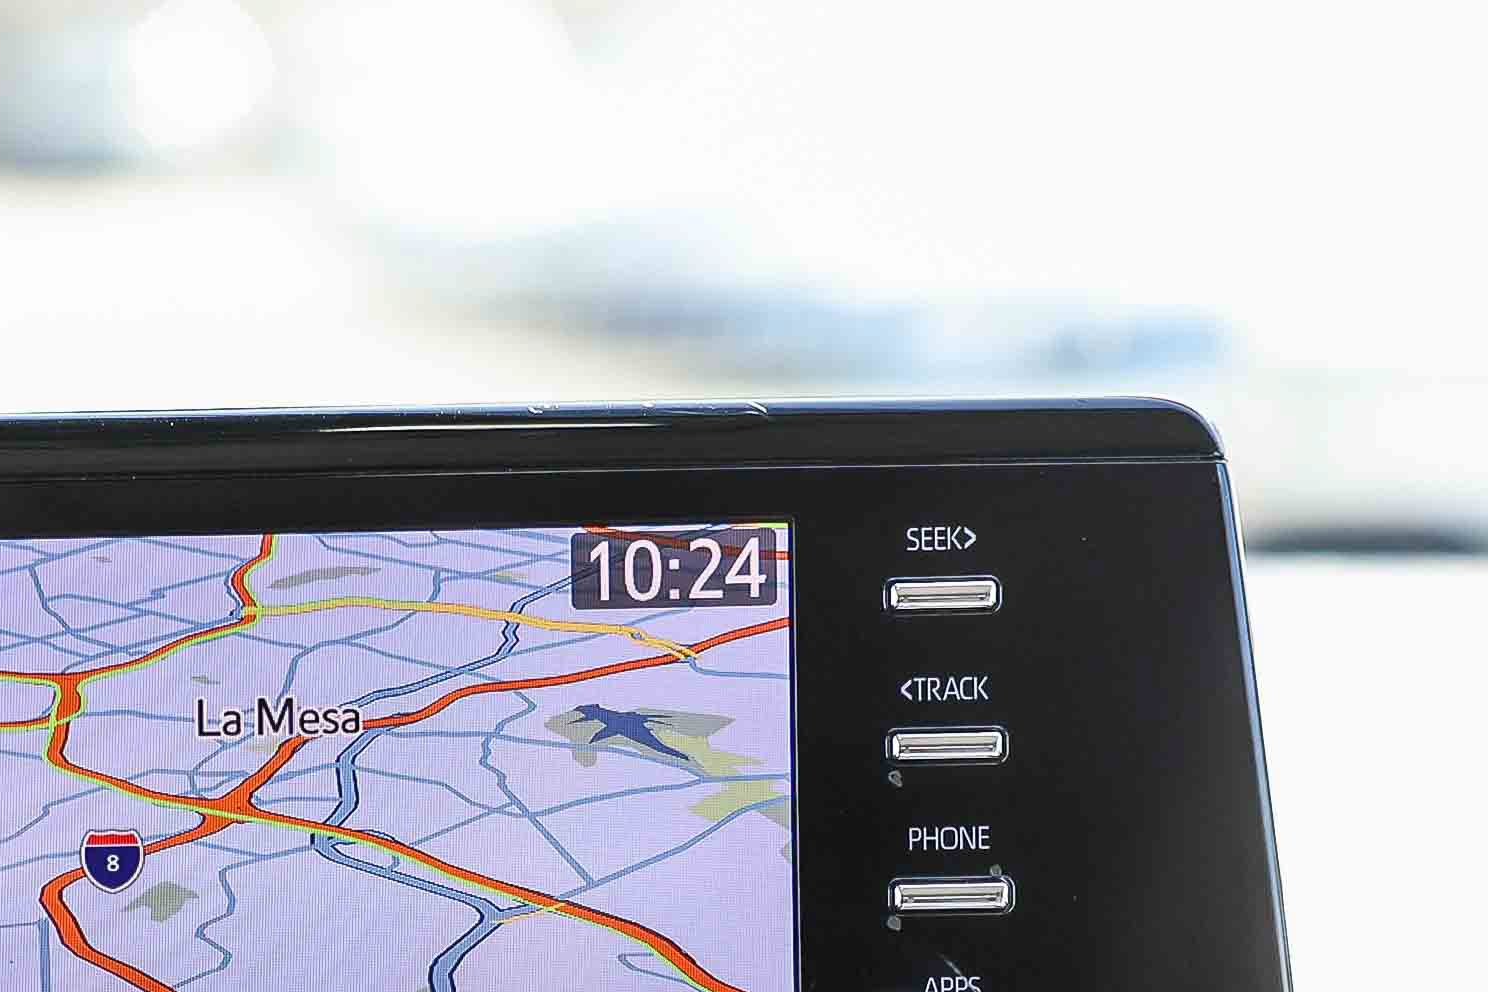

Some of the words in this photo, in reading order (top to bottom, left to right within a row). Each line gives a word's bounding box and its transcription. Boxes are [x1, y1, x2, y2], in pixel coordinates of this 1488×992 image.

[589, 536, 768, 602] 10:24
[197, 698, 242, 737] La
[254, 695, 362, 736] Mesa
[908, 825, 990, 851] PHONE
[106, 854, 120, 872] 8
